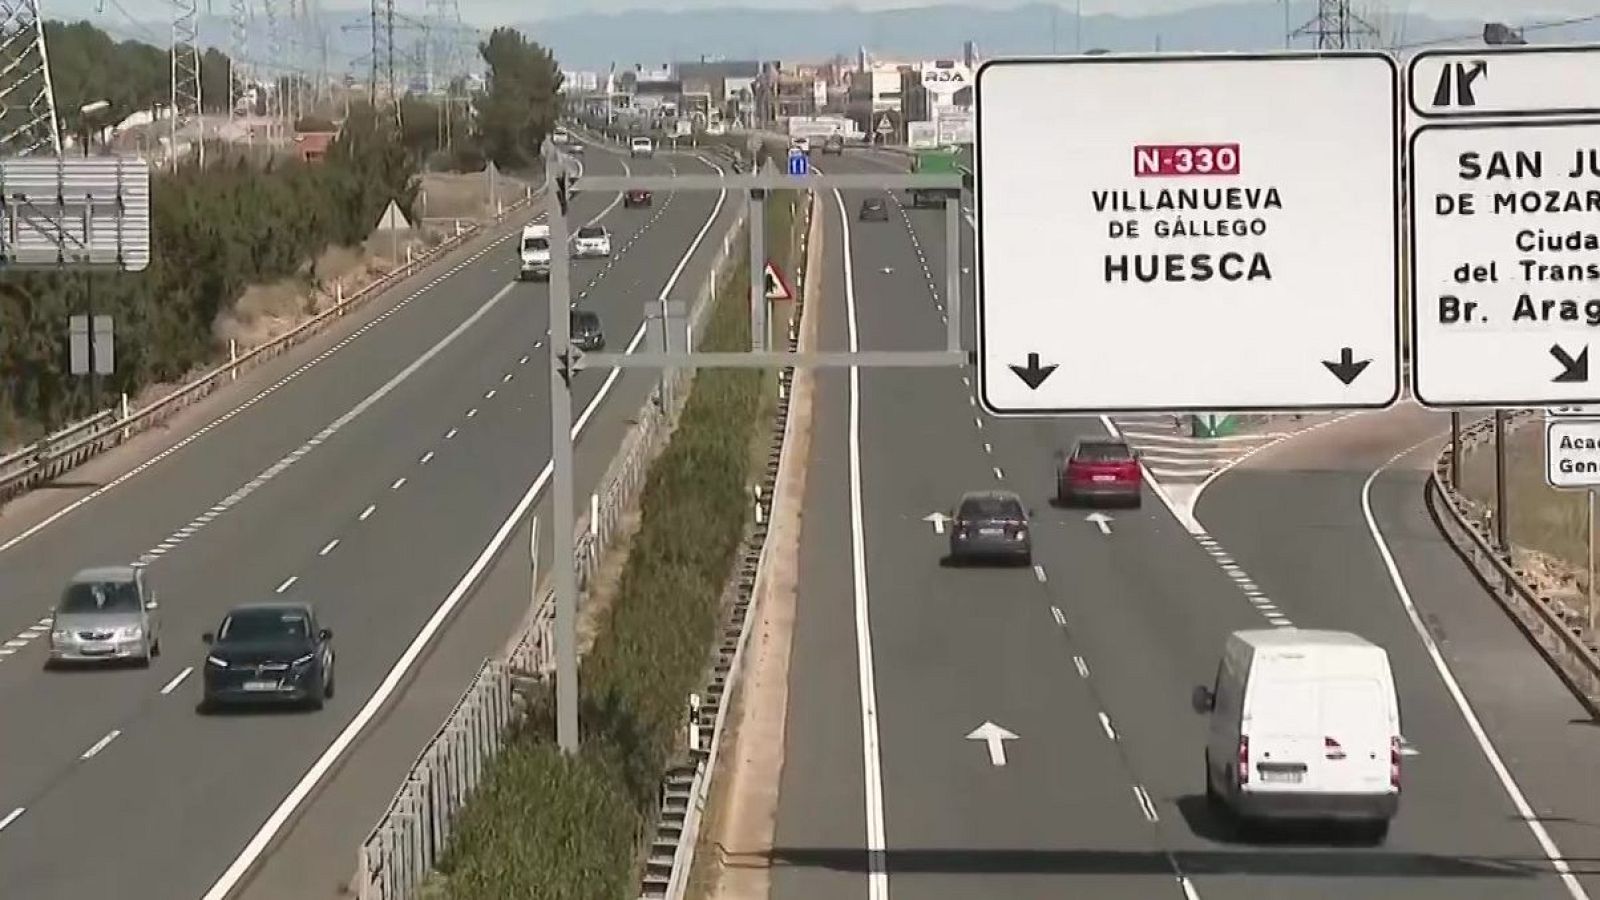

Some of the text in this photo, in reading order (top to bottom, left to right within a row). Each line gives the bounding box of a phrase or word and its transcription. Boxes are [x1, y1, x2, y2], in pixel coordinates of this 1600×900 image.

[1137, 148, 1237, 173] N-330
[1458, 150, 1542, 180] SAN
[1091, 187, 1282, 212] VILLANUEVA
[1435, 190, 1600, 215] DE MOZAR
[1109, 215, 1267, 238] DE GÁLLEGO
[1515, 229, 1599, 252] Ciuda
[1104, 252, 1272, 282] HUESCA
[1453, 260, 1600, 283] del Trans
[1438, 294, 1600, 327] Br. Arag
[1559, 435, 1600, 449] Aca
